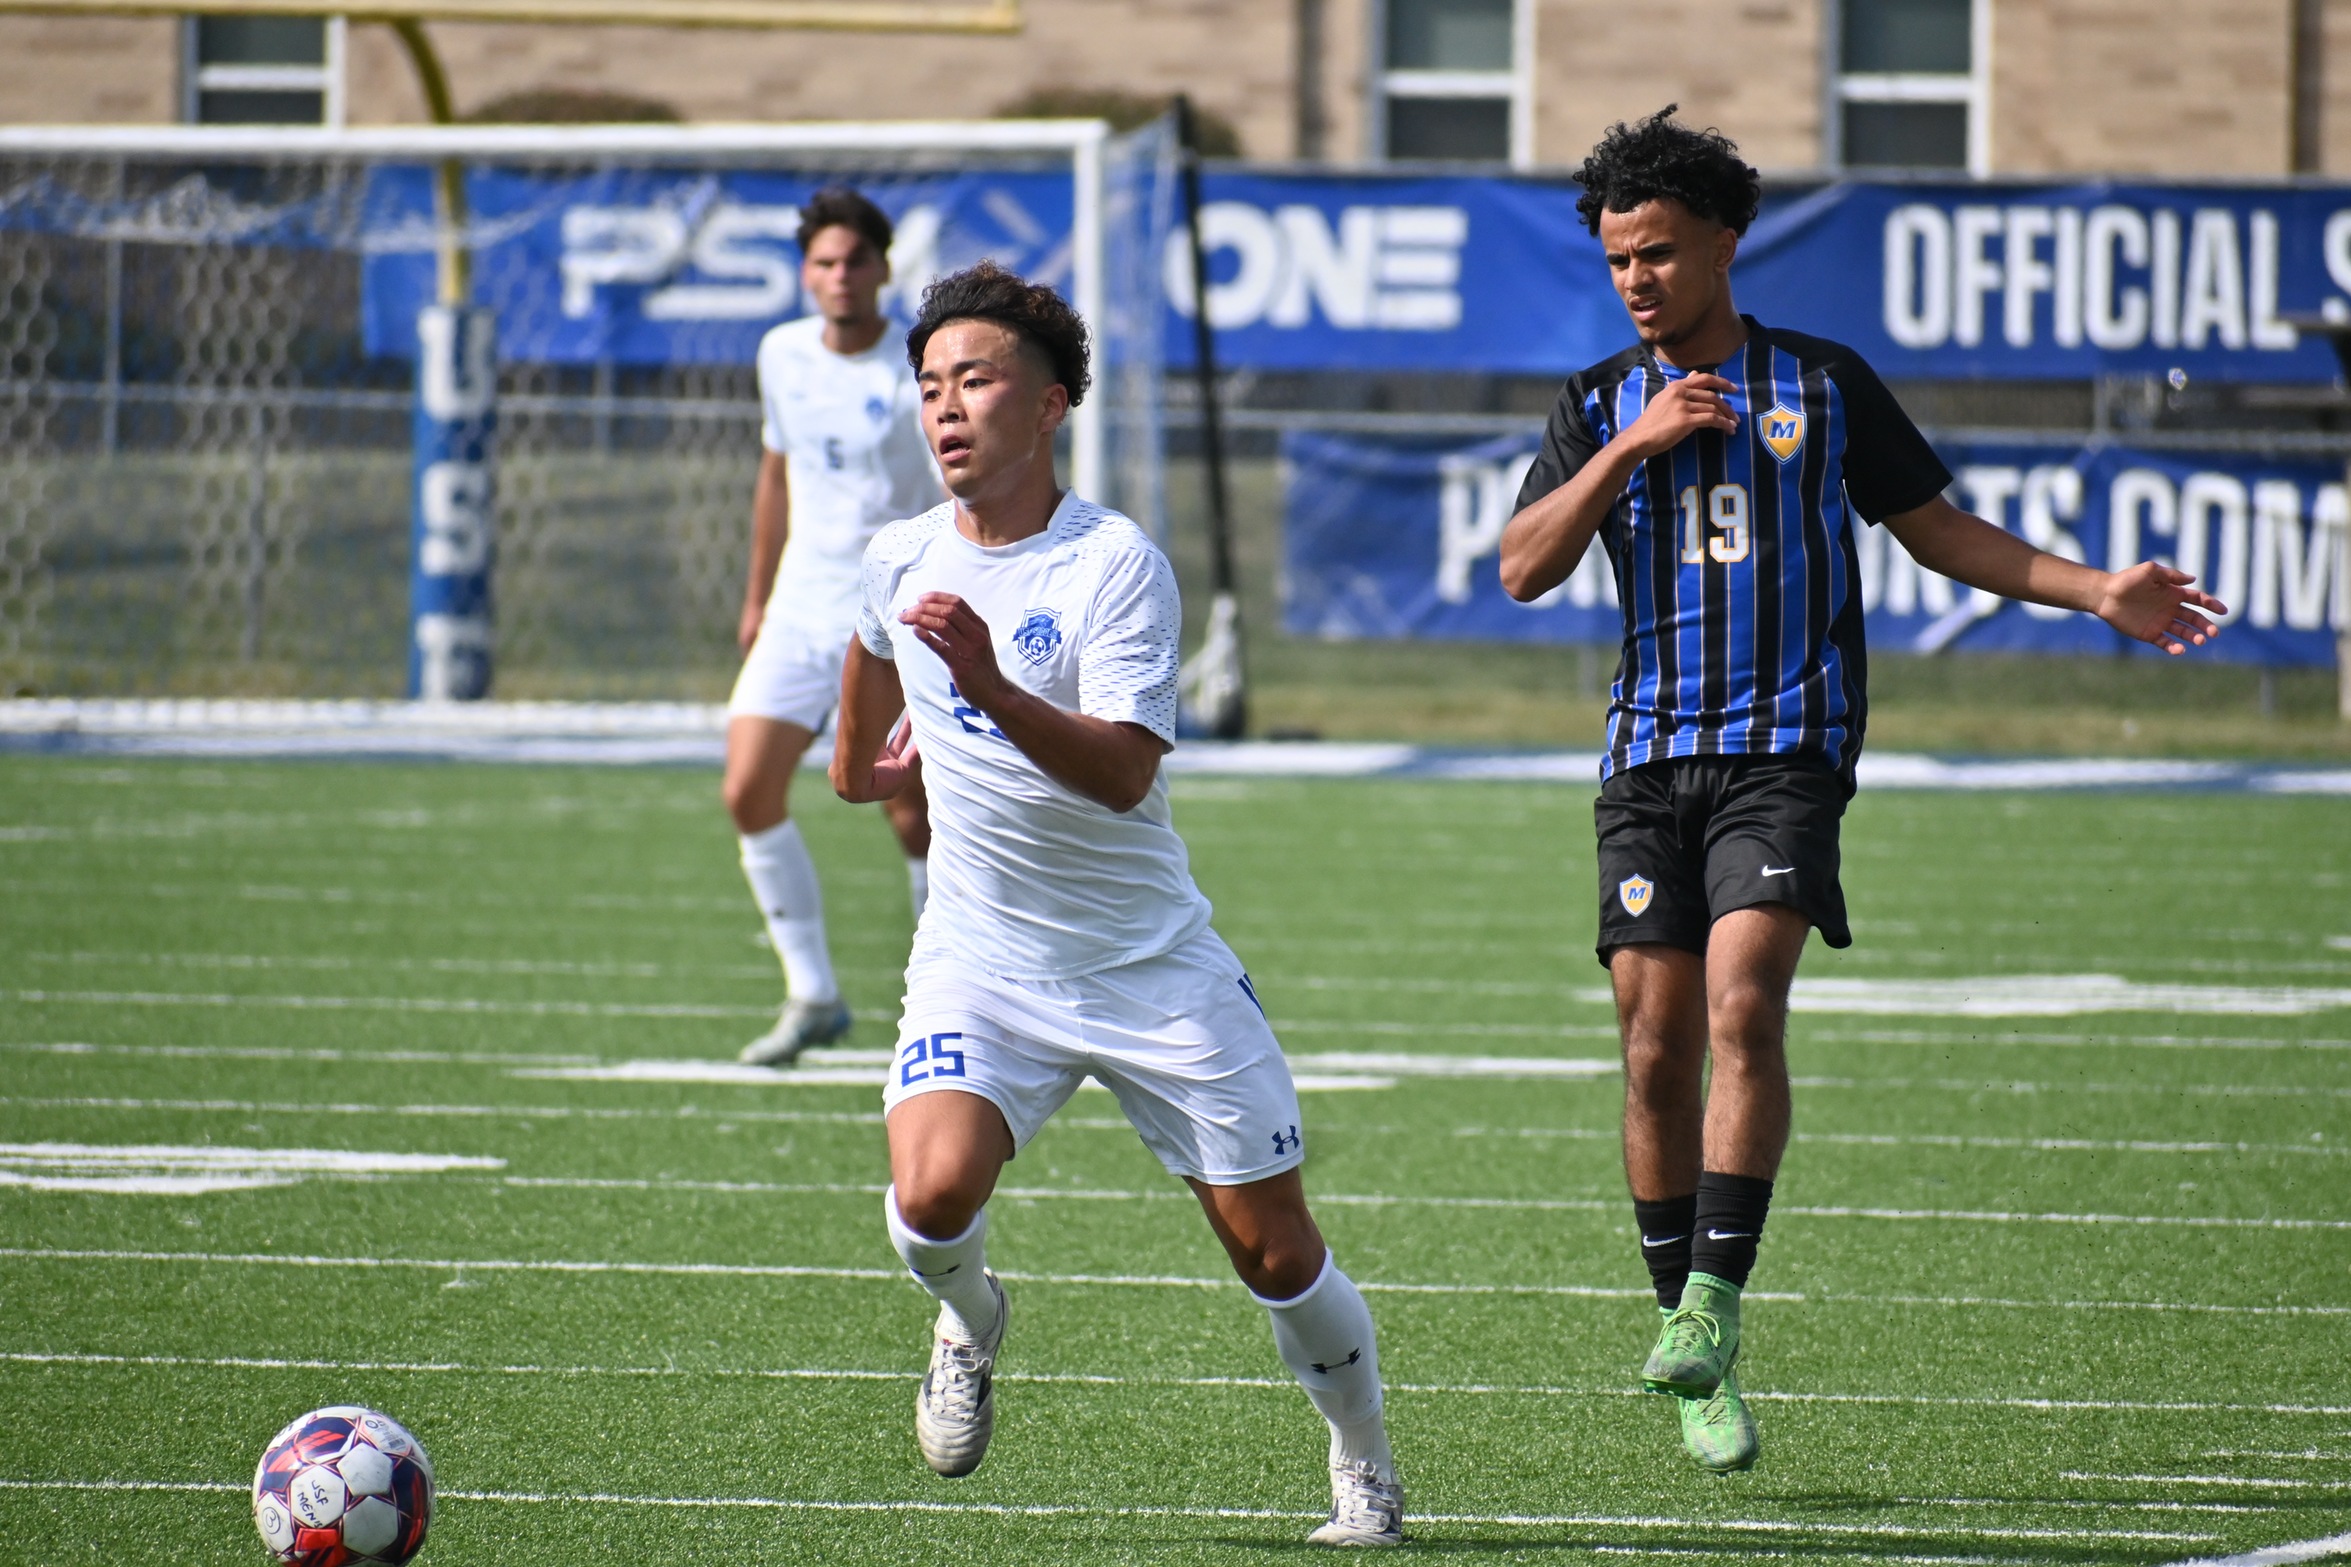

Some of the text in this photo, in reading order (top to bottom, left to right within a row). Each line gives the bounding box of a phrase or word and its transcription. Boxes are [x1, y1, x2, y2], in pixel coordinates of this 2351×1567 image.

[1163, 200, 1467, 330] ONE
[1883, 203, 2298, 349] OFFICIAL
[1769, 420, 1797, 440] M
[1680, 484, 1749, 563] 19
[1627, 886, 1647, 901] M
[901, 1032, 966, 1087] 25
